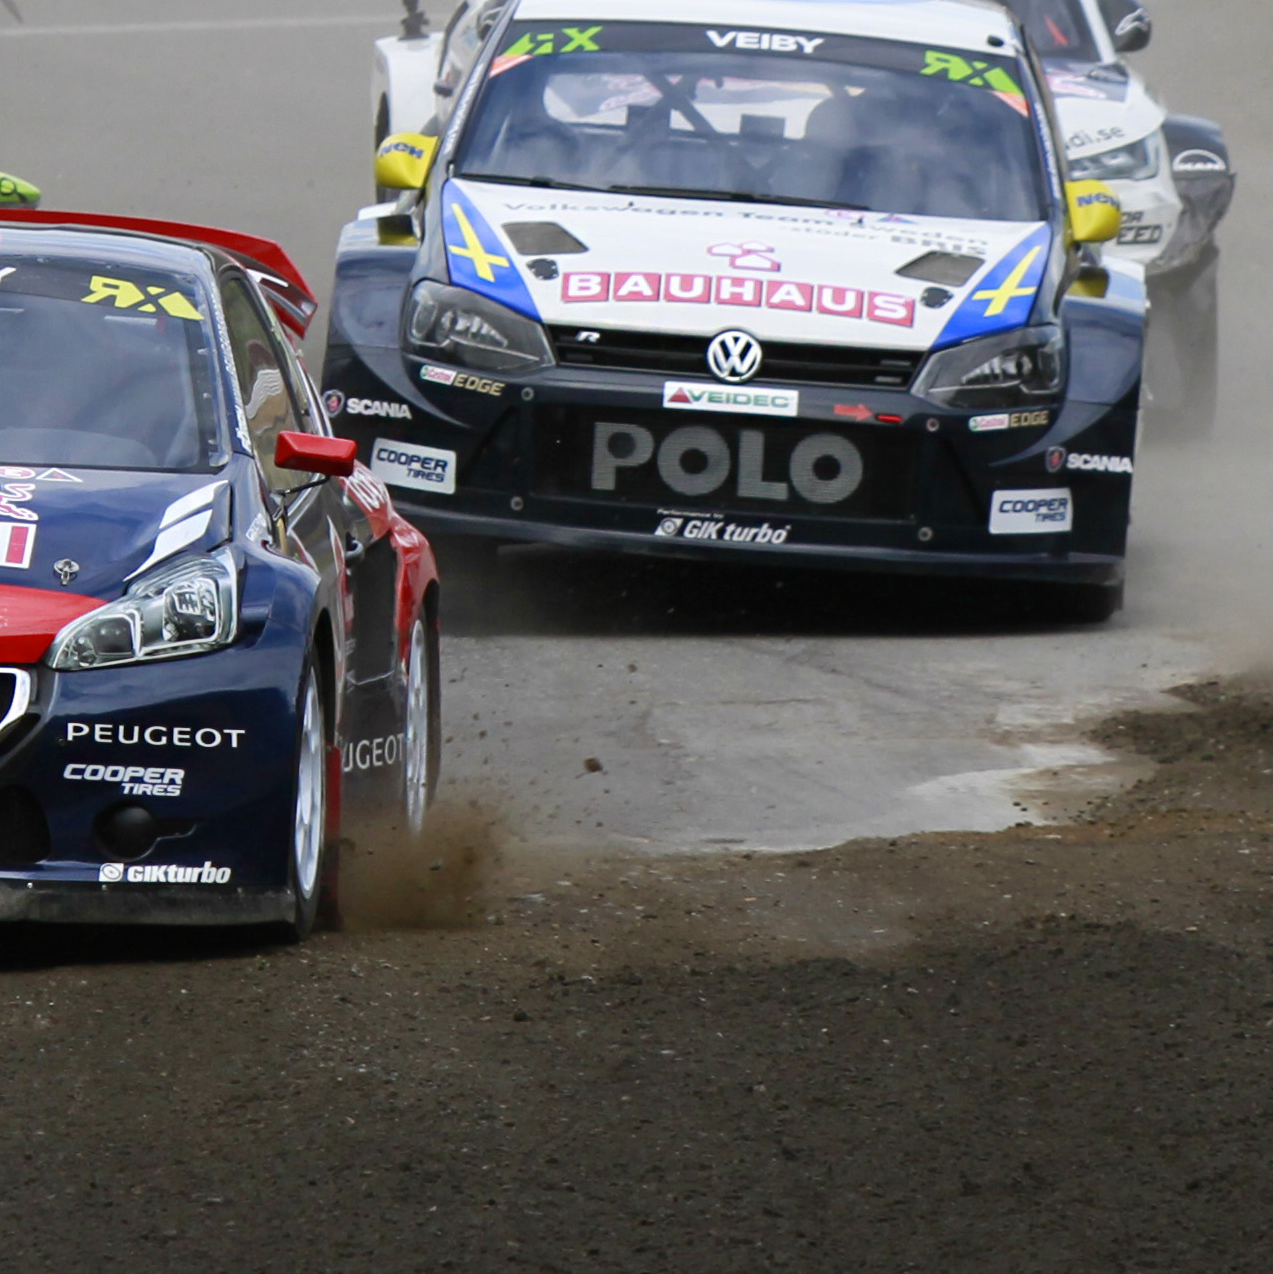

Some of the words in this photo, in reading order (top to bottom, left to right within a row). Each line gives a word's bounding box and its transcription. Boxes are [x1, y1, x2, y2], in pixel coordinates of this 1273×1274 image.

[705, 29, 826, 55] VEIBY
[503, 201, 725, 219] Volkswagen
[738, 211, 835, 227] Team
[565, 273, 914, 325] BAUHAUS
[454, 372, 507, 397] EDGE
[346, 397, 413, 421] SCANIA
[686, 389, 790, 409] VEIDEC
[1010, 409, 1050, 428] EDGE
[376, 447, 448, 473] COOPER
[590, 421, 864, 504] POLO
[1066, 452, 1134, 474] SCANIA
[406, 467, 446, 483] TIRES
[998, 497, 1069, 514] COOPER
[1034, 512, 1068, 524] TIRES
[682, 518, 726, 540] GIK
[724, 523, 790, 545] turbo
[66, 722, 246, 749] PEUGEOT
[63, 763, 185, 785] COOPER
[120, 782, 182, 797] TIRES
